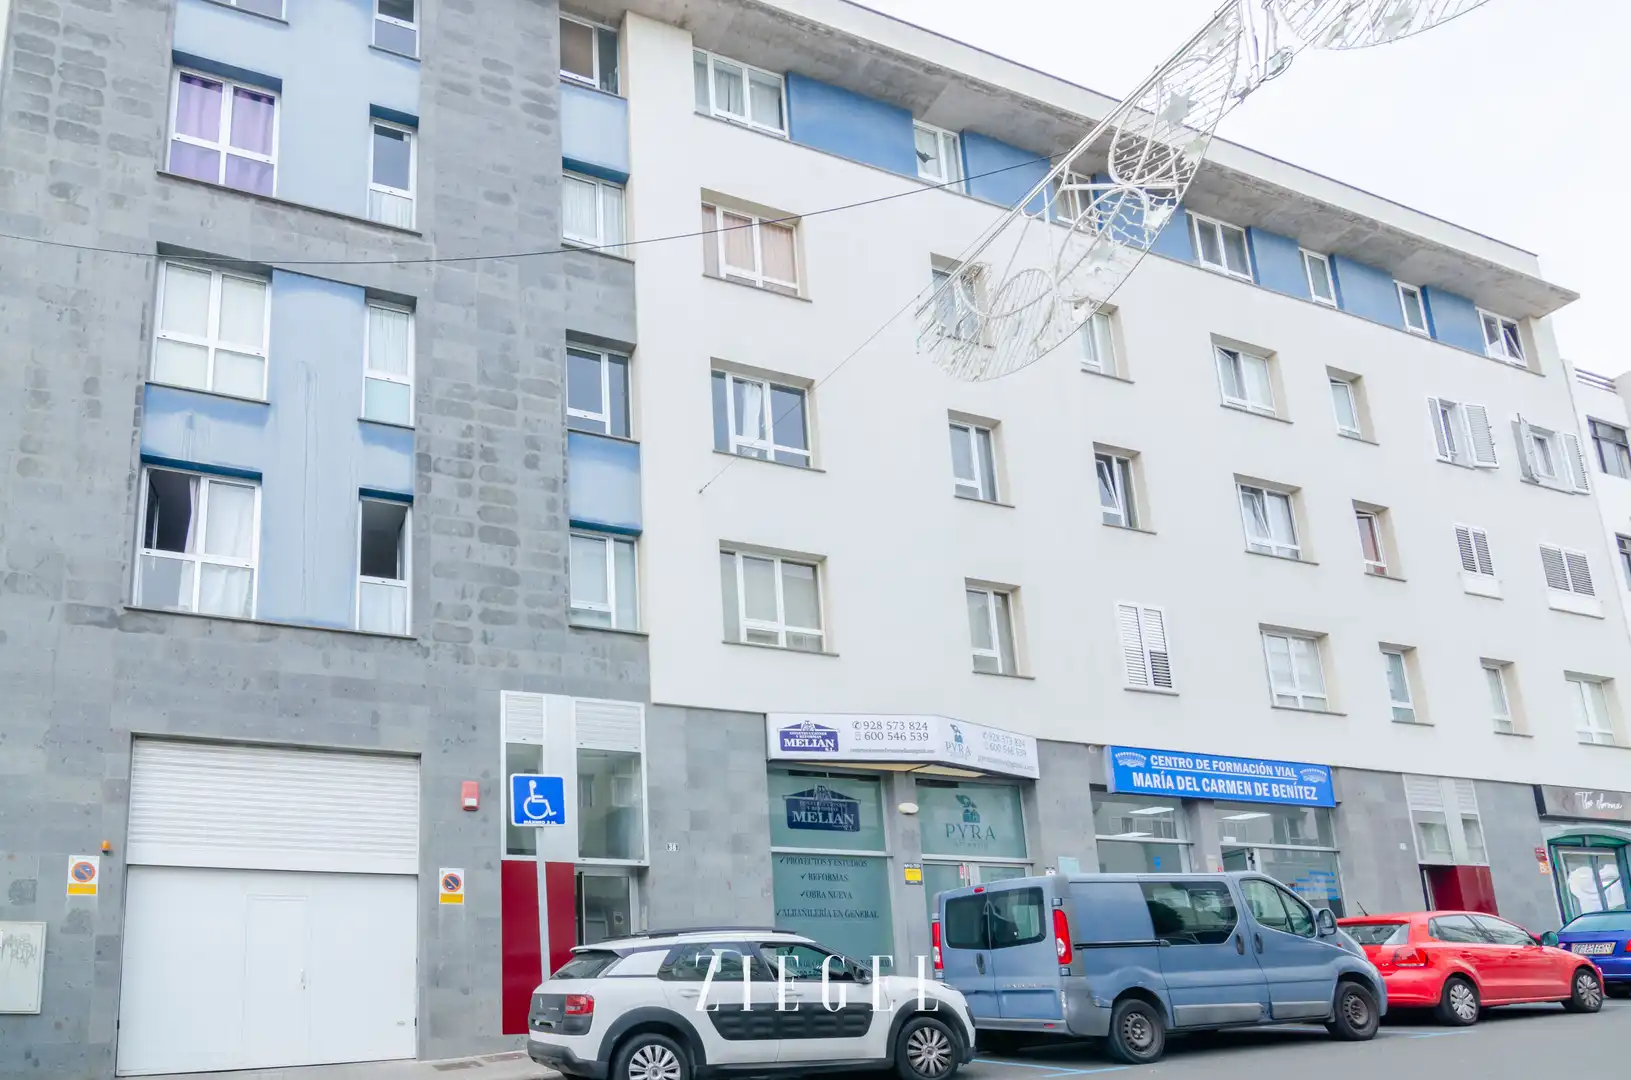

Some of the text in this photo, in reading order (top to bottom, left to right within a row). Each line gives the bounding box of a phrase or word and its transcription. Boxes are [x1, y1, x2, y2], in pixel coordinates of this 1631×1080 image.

[863, 721, 928, 731] 928 573 824
[864, 731, 929, 741] 600 546 539
[783, 738, 835, 748] MELIAN
[945, 740, 972, 756] PYRA
[1150, 754, 1194, 769] CENTRO
[1195, 758, 1210, 771] DE
[1212, 760, 1274, 776] FORMACIÓN
[1274, 766, 1298, 778] VIAL
[1132, 770, 1319, 801] MARÍA DEL CARMEN DE BENÍTEZ
[791, 810, 855, 825] MELIAN
[944, 822, 996, 841] PYRA
[785, 856, 868, 868] PROYECTOS Y ESTUDIOS
[808, 872, 849, 881] REFORMAS
[805, 889, 853, 899] OBRA NUEVA
[782, 907, 879, 919] ALBAÑILERÍA EN GENERAL
